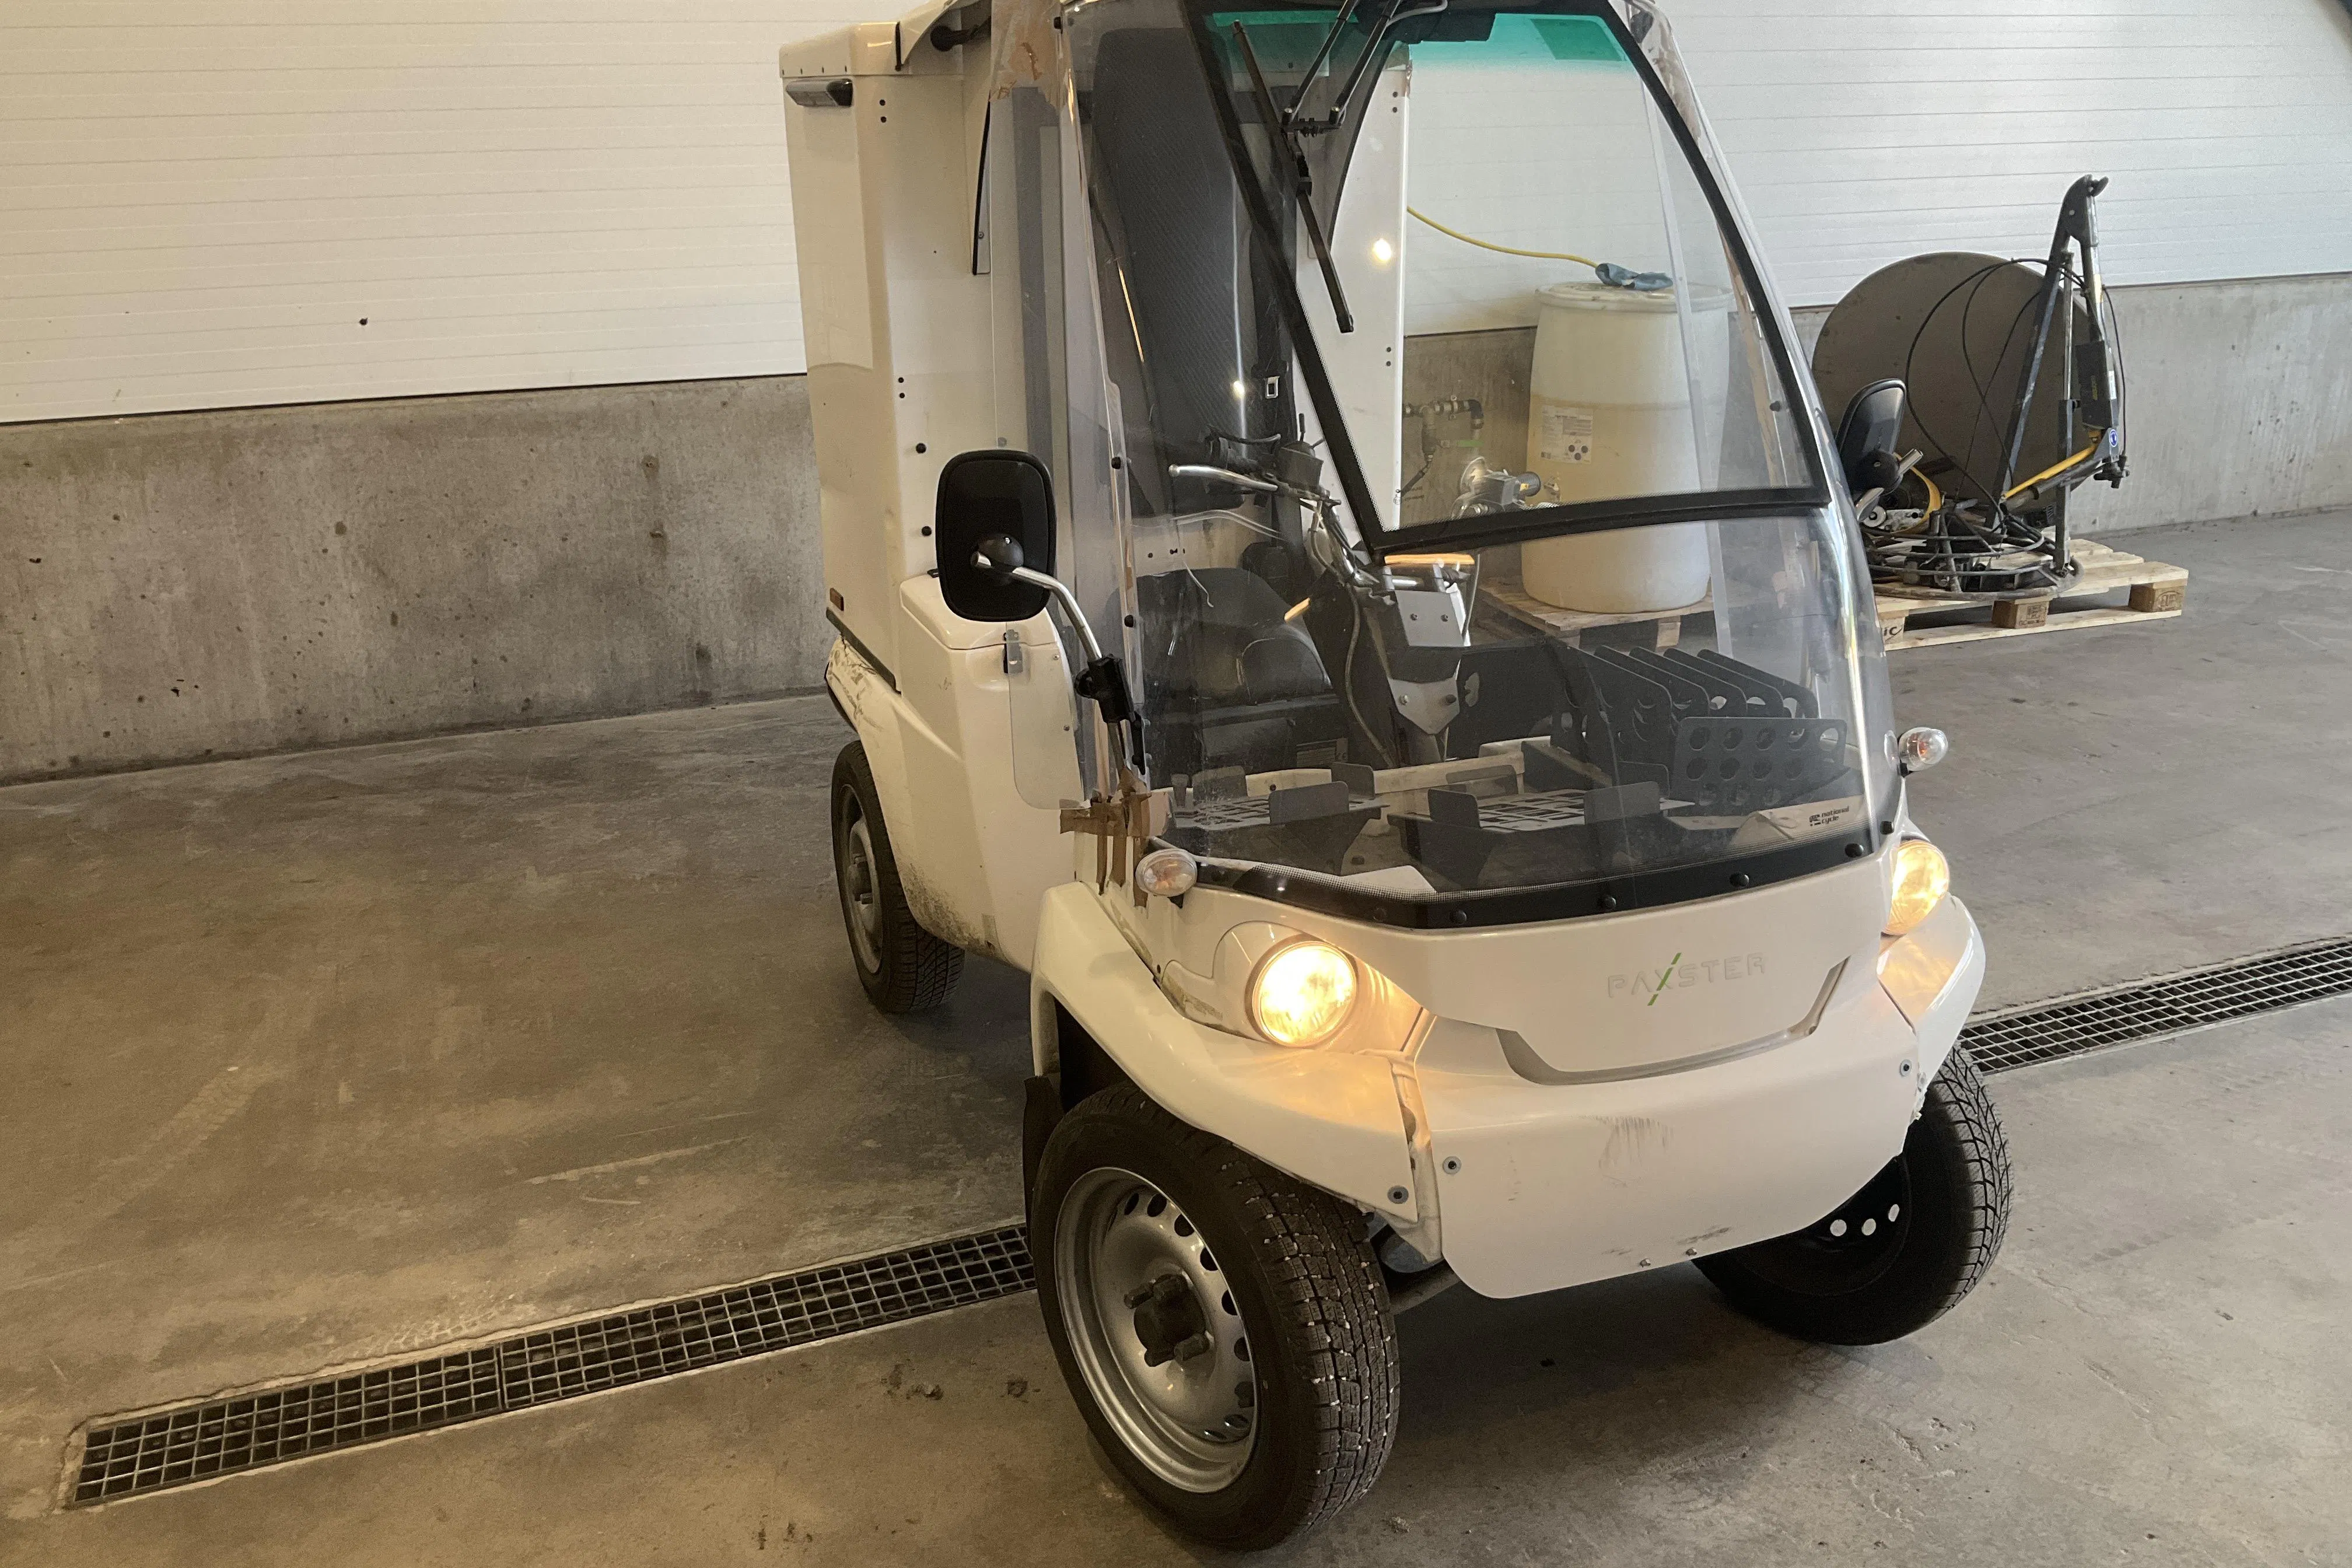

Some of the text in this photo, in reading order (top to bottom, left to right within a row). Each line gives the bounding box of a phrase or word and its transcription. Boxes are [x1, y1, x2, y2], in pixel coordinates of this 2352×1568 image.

[1821, 806, 1849, 817] national
[1821, 816, 1839, 824] cycle
[1608, 952, 1765, 1006] PAXSTER
